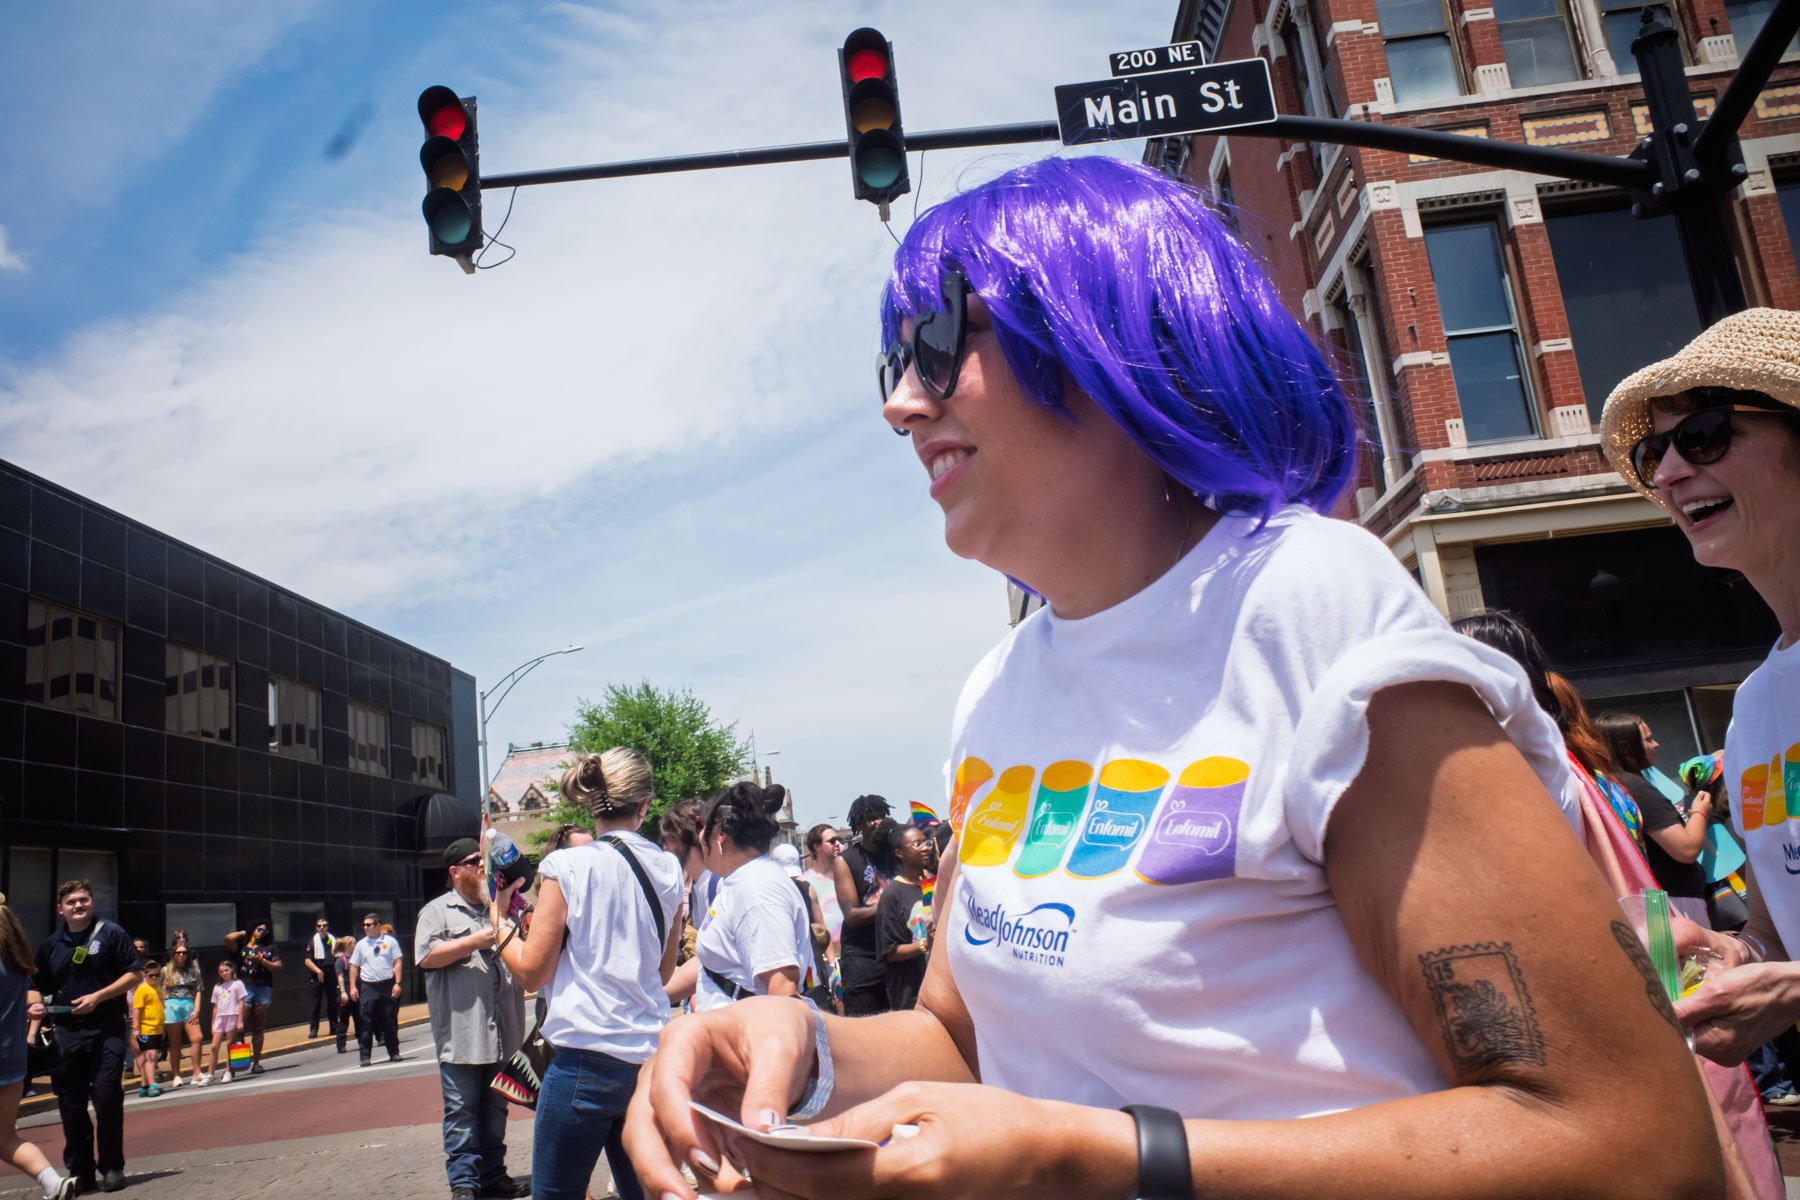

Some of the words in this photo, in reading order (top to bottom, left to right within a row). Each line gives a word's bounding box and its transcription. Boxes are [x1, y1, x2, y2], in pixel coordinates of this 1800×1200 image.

[1117, 50, 1157, 70] 200
[1168, 44, 1195, 64] NE
[1084, 90, 1177, 128] Main
[1200, 79, 1243, 113] St
[1088, 816, 1139, 838] Enfamil
[1164, 818, 1222, 839] Enfamil
[1013, 948, 1065, 967] NUTRITION
